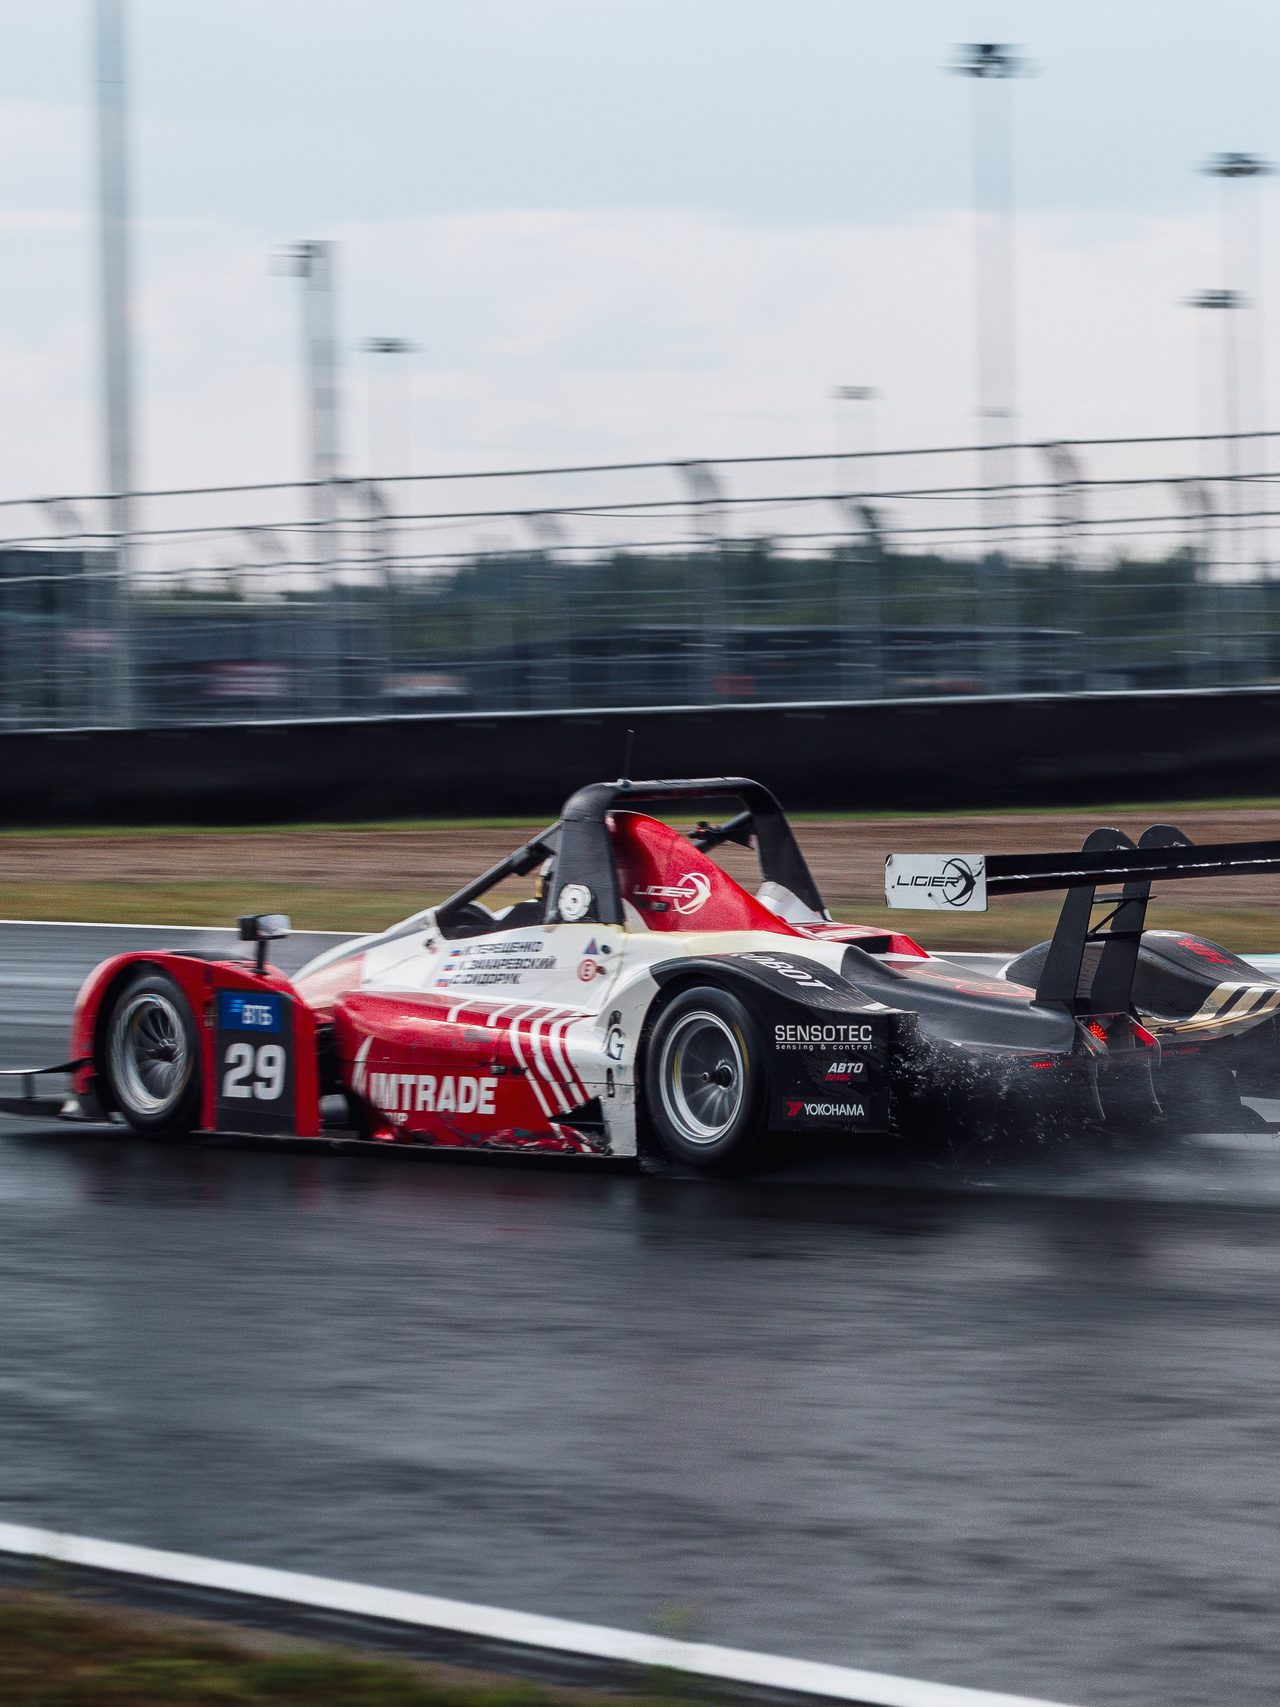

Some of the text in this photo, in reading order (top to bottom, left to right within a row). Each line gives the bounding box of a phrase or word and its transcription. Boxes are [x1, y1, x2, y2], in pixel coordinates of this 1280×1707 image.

[896, 875, 959, 888] LIGIER
[736, 953, 834, 991] OBOT
[775, 1025, 872, 1041] SENSOTEC
[221, 1042, 287, 1100] 29
[828, 1062, 864, 1073] АВТО
[804, 1103, 865, 1116] YOKOHAMA
